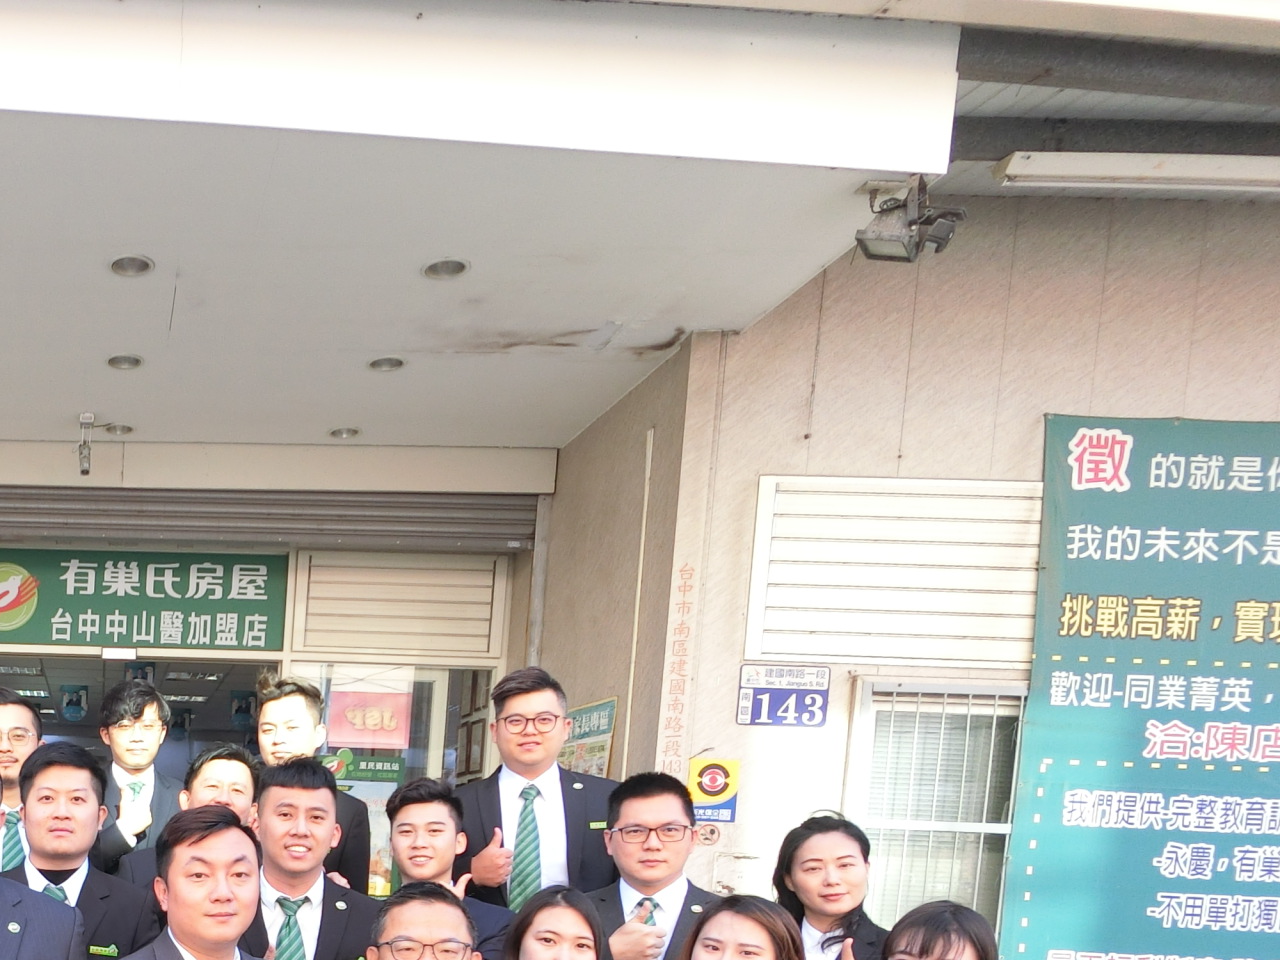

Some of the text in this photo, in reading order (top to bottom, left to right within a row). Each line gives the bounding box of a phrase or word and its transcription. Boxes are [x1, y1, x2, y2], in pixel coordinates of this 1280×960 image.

[1070, 429, 1131, 490] 徵
[59, 558, 270, 601] 有巢氏房屋
[50, 607, 268, 649] 台中中山醫加盟店
[764, 668, 826, 680] 建國南路一段
[754, 692, 824, 725] 143
